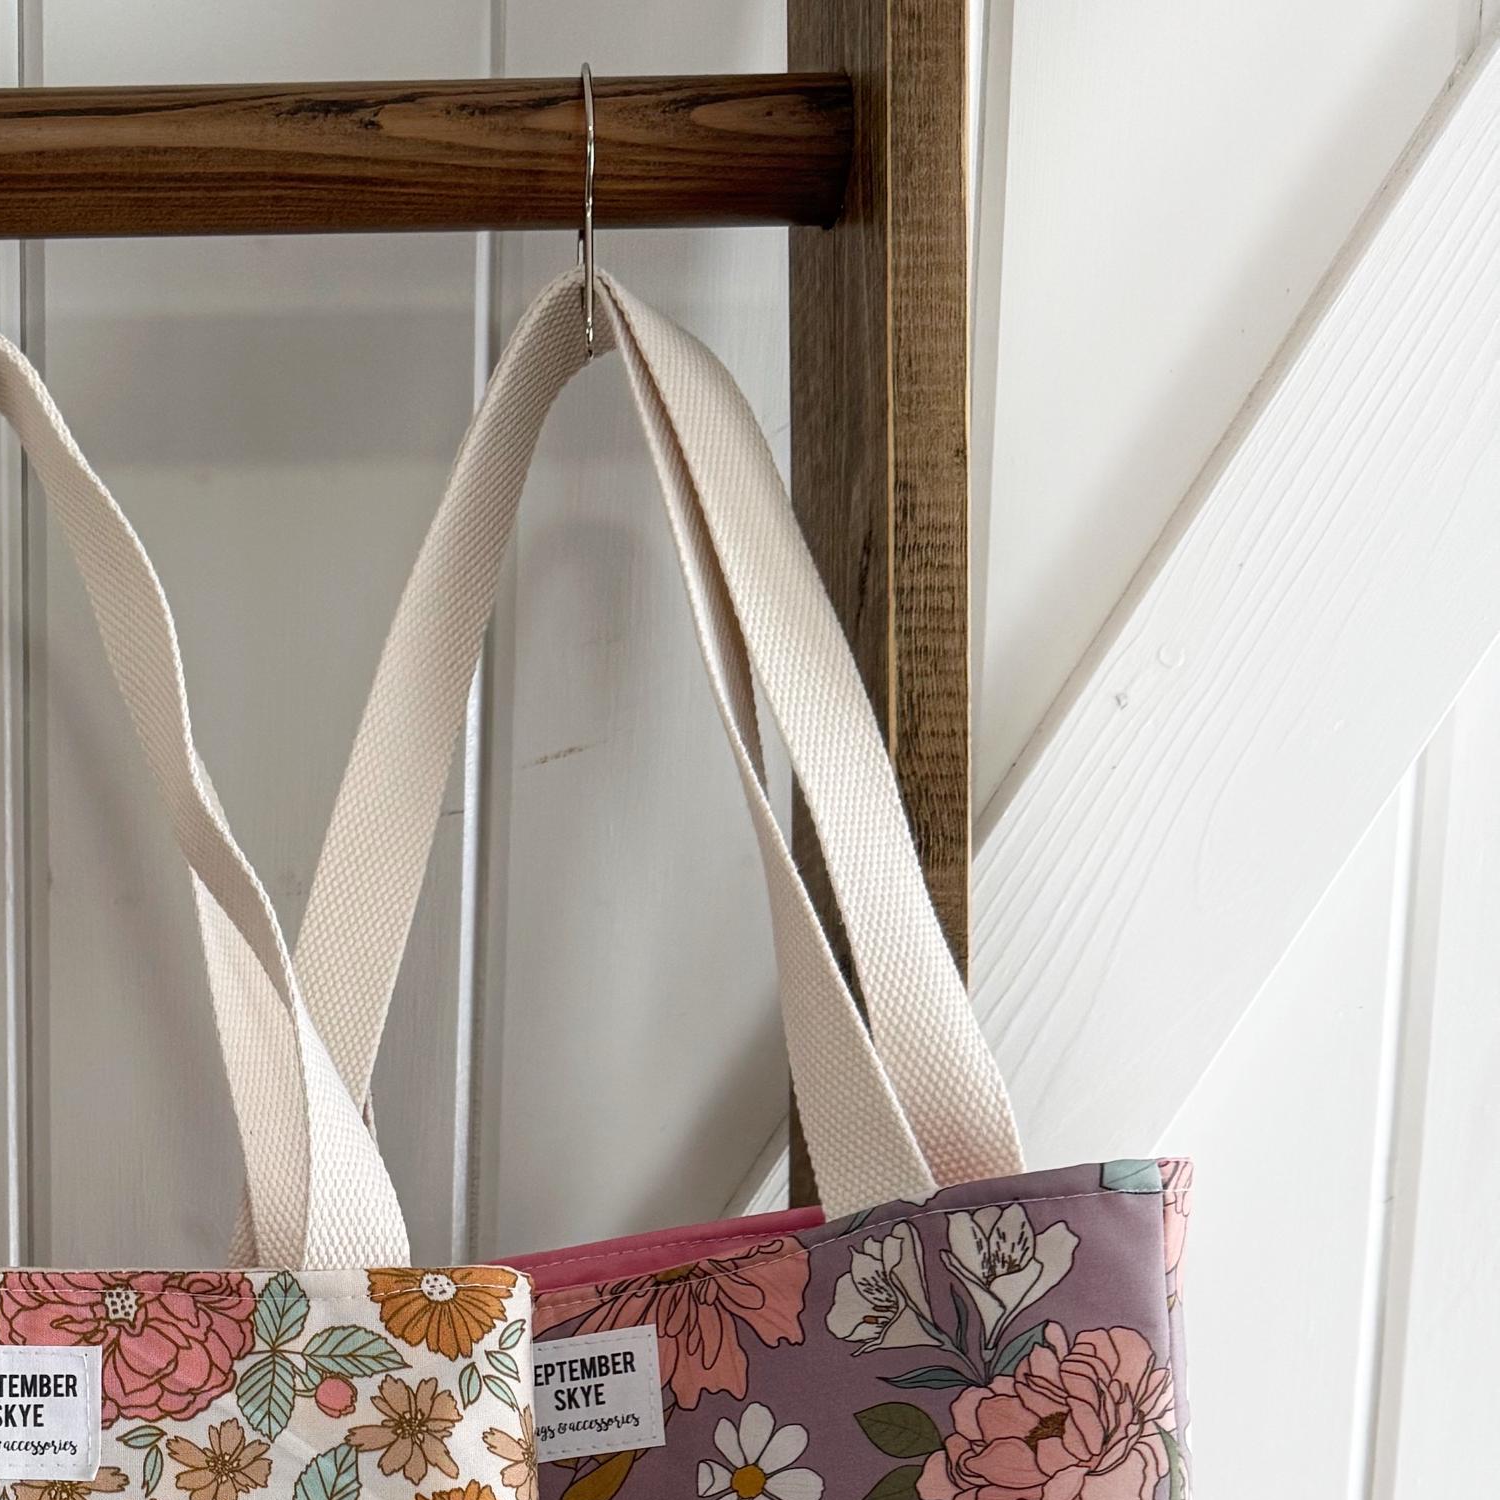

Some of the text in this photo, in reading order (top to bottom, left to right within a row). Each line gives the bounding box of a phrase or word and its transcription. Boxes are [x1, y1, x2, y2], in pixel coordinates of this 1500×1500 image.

[534, 1351, 636, 1387] EPTEMBER
[554, 1383, 606, 1412] SKYE
[535, 1424, 555, 1441] ags
